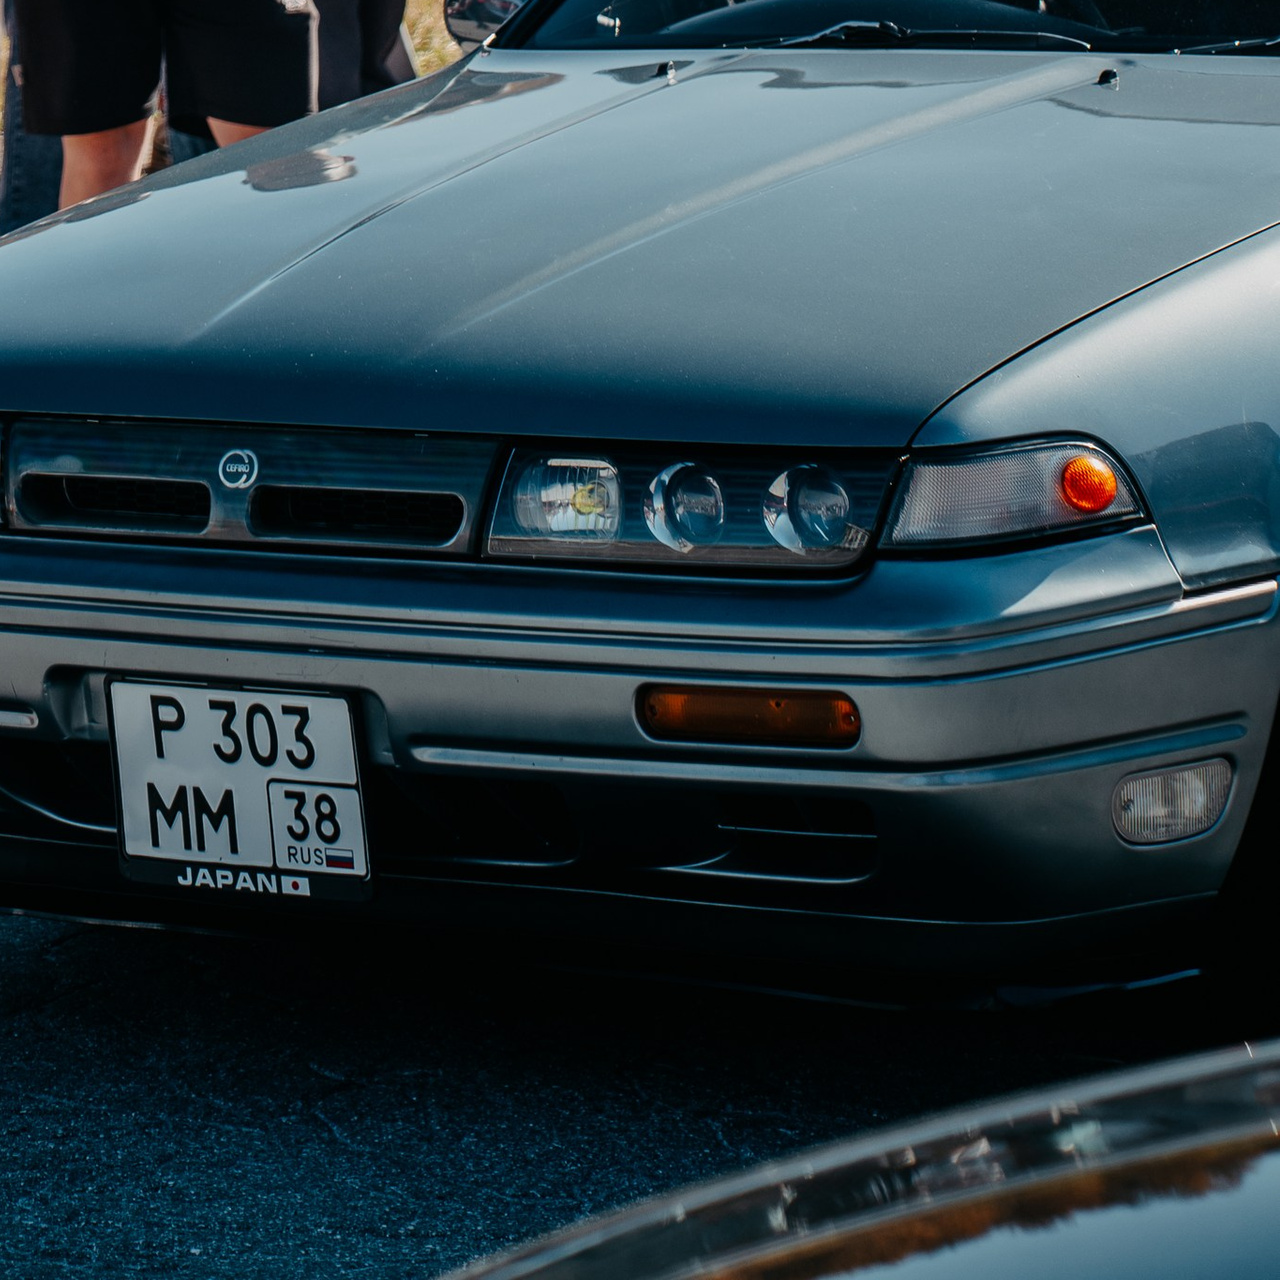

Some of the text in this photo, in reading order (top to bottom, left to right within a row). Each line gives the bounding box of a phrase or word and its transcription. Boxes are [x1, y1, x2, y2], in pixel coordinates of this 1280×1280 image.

[225, 463, 250, 473] CEFIRO
[208, 699, 316, 770] 303
[146, 781, 341, 855] ММ 38
[287, 845, 325, 866] RUS
[177, 866, 278, 894] JAPAN
